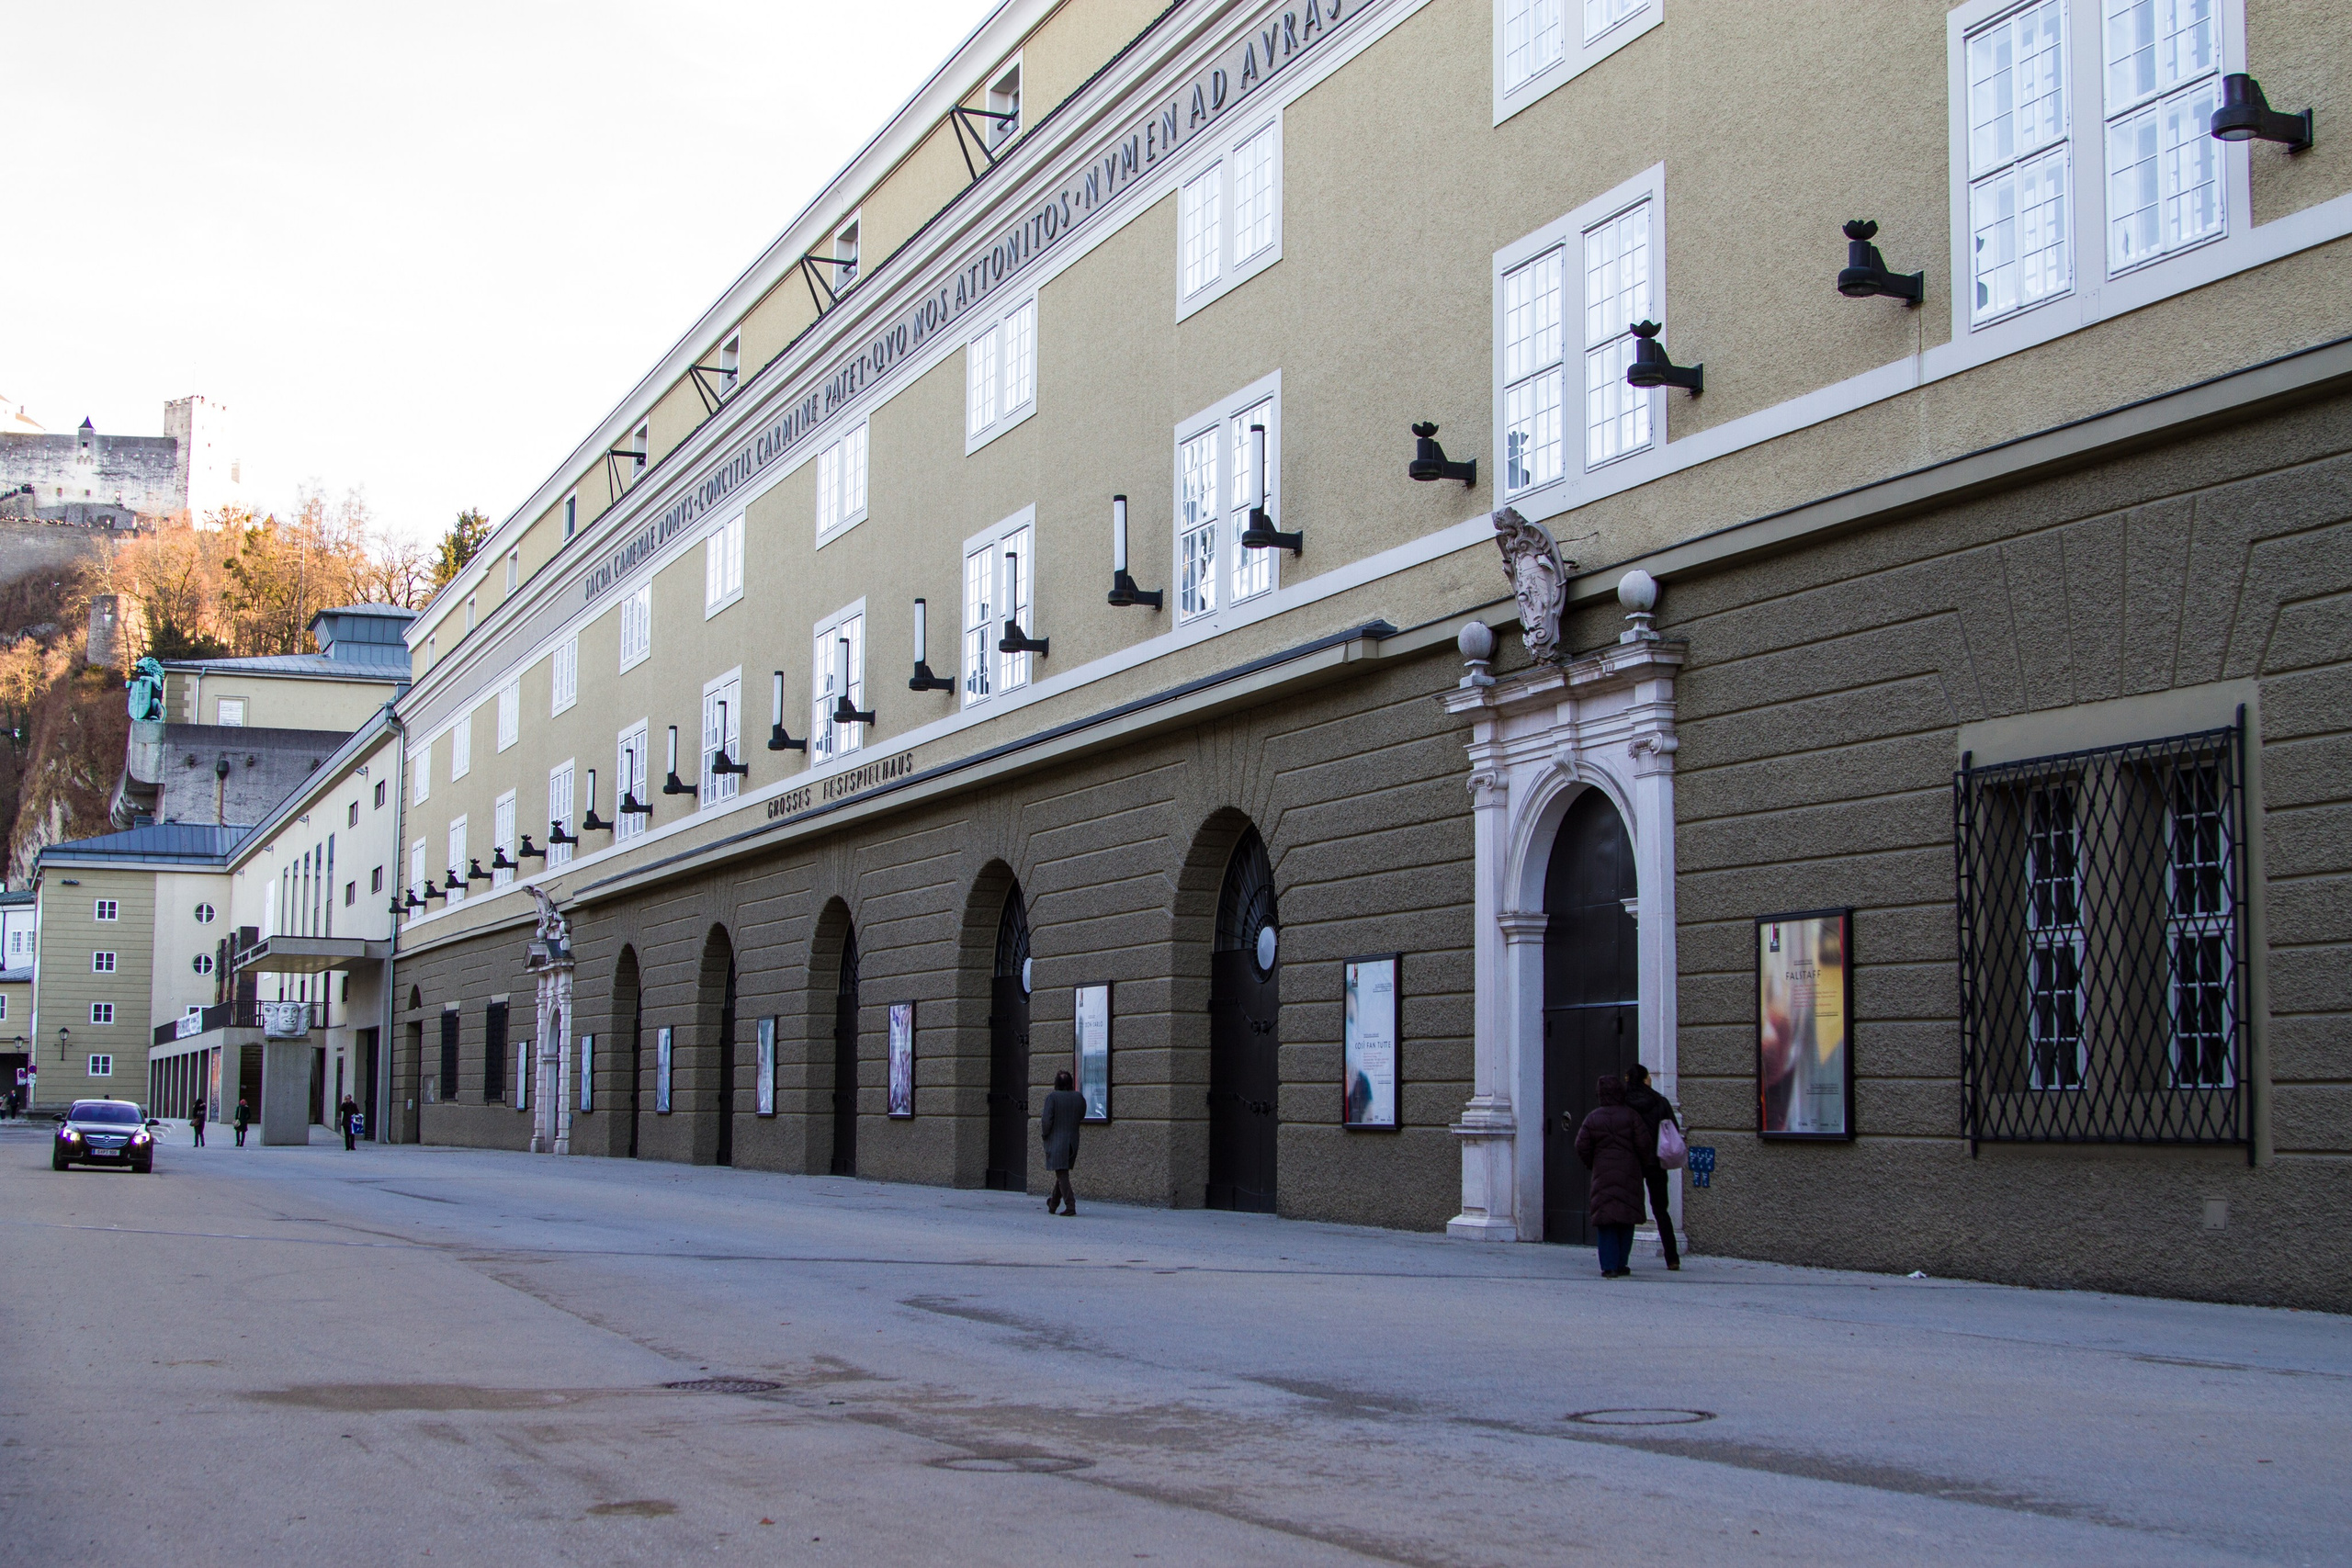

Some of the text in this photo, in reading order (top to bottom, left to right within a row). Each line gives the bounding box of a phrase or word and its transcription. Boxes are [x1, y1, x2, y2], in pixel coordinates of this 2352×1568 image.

[584, 562, 612, 601] SACRA
[614, 525, 655, 579] CAMENAE
[658, 495, 694, 544] DOMVS
[698, 448, 752, 511] CONCITIS
[756, 393, 820, 465] CARMINE
[825, 355, 865, 413] PATET
[872, 323, 908, 373] QVO
[912, 288, 947, 344] NOS
[956, 190, 1070, 310] ATTONITOS
[1085, 102, 1178, 209] NVMEN
[1189, 68, 1227, 129] AD
[767, 751, 913, 819] GROSSES FESTSPIELHAUS
[1785, 969, 1821, 980] FALSTAFF
[1366, 1041, 1376, 1049] FAN
[1377, 1040, 1391, 1049] TUTTE
